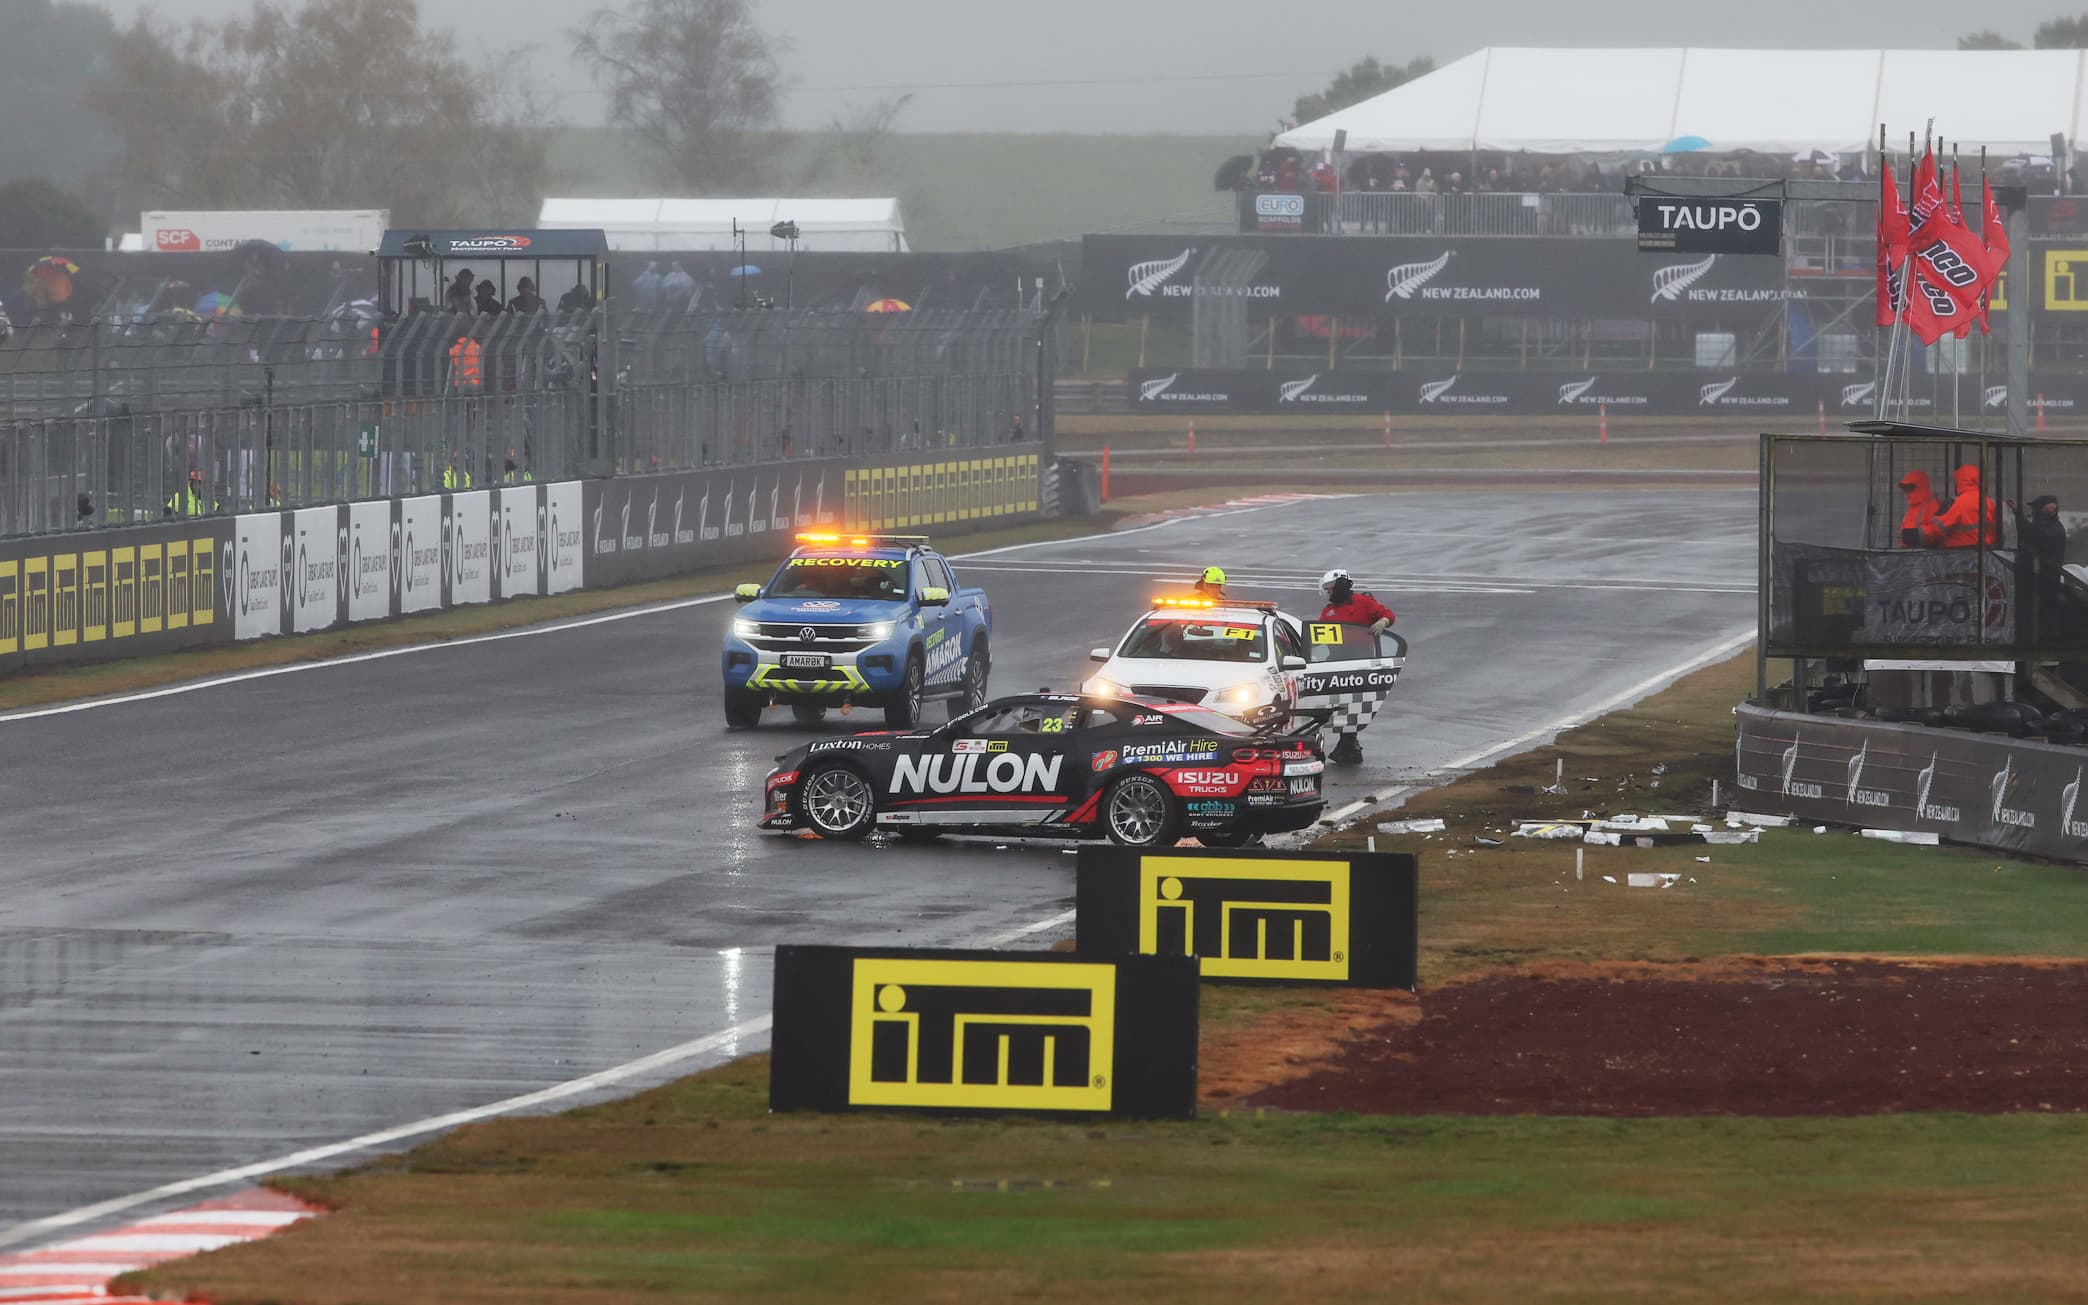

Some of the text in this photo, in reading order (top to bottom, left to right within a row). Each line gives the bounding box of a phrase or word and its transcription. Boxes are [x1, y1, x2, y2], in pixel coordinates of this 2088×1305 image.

[1261, 199, 1299, 211] EURO
[1658, 203, 1761, 231] TAUPŌ
[159, 231, 190, 244] SCF
[1163, 284, 1193, 297] NEW
[1422, 287, 1540, 299] NEW ZEALAND.COM
[1688, 289, 1718, 301] NEW
[789, 557, 904, 569] RECOVERY
[1224, 627, 1252, 639] F1
[1313, 625, 1340, 643] F1
[924, 631, 962, 678] AMAROK
[1328, 675, 1364, 688] Auto
[1042, 717, 1063, 733] 23
[862, 742, 892, 751] HOMES
[1122, 739, 1218, 757] PremiAir Hire
[1138, 752, 1214, 763] 1300 WE HIRE
[888, 752, 1064, 794] NULON
[1177, 771, 1239, 785] ISUZU
[1120, 776, 1155, 786] DUNLOP
[1290, 776, 1315, 795] NULON
[1188, 785, 1228, 794] TRUCKS
